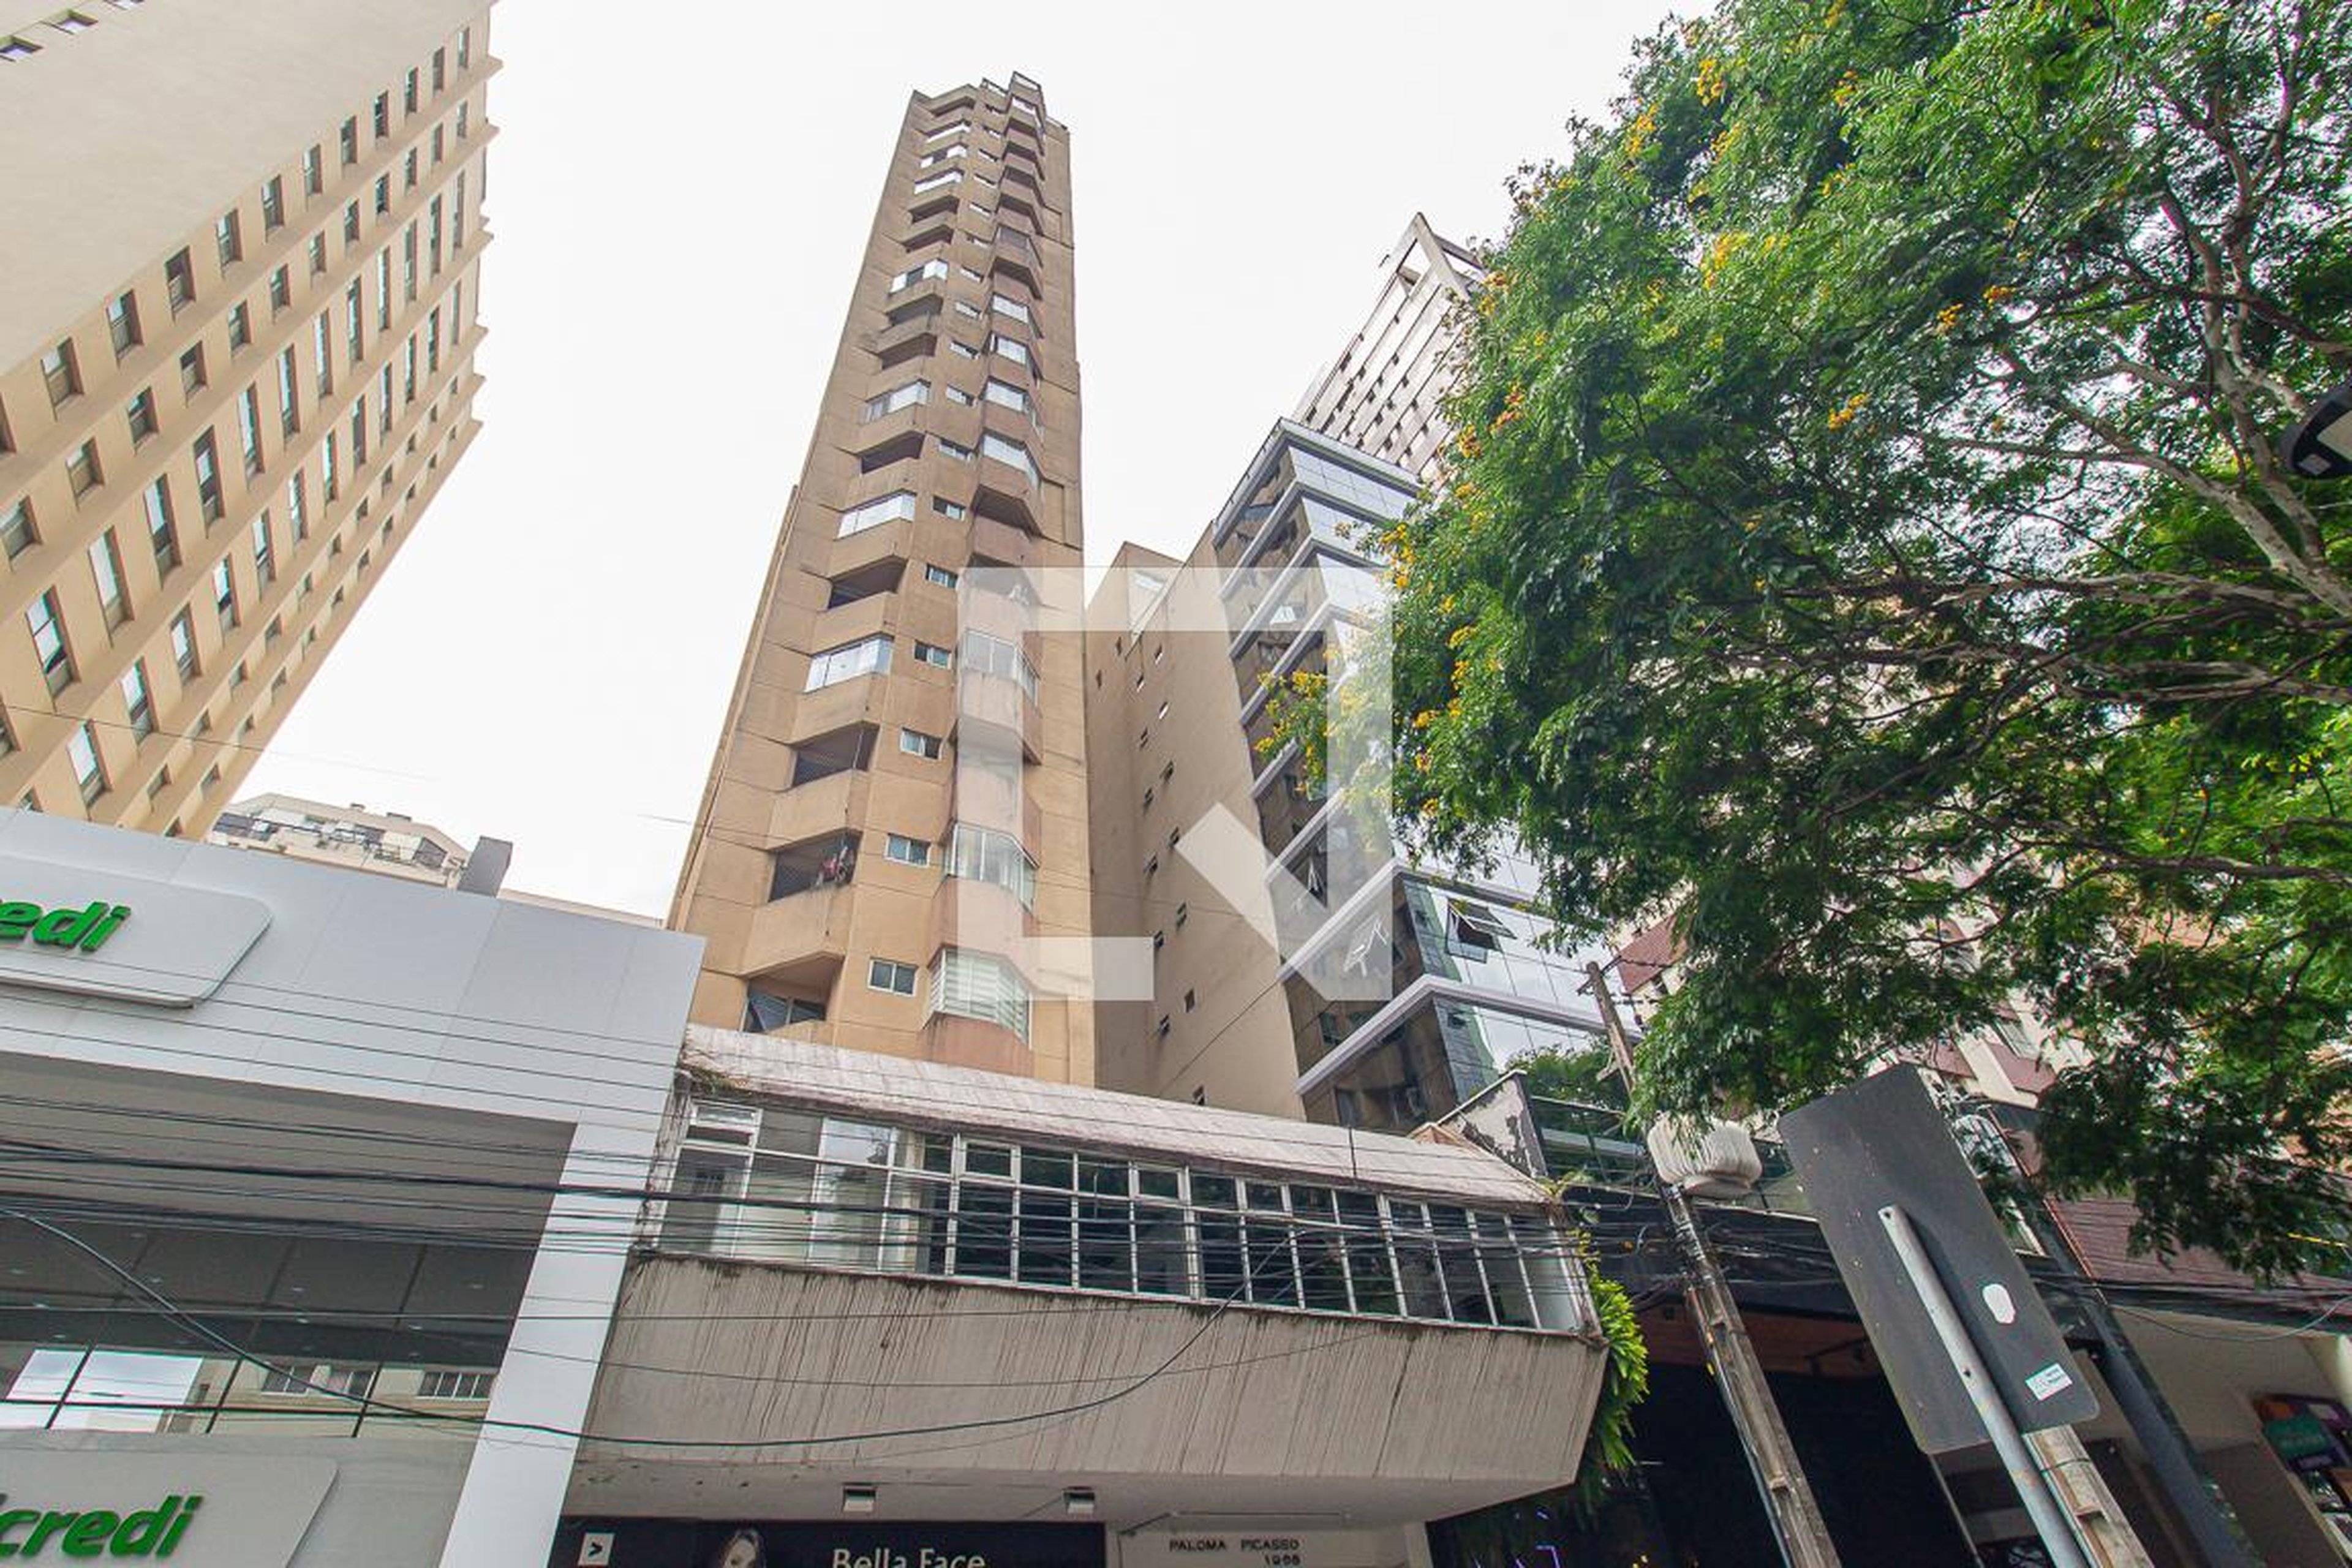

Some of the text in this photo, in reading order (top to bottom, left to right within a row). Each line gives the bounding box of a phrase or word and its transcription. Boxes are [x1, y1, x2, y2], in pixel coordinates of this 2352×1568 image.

[0, 899, 131, 951] edi
[0, 1493, 203, 1558] credi
[833, 1548, 986, 1568] Bella Face
[1169, 1539, 1300, 1551] PALOMA PICASSO
